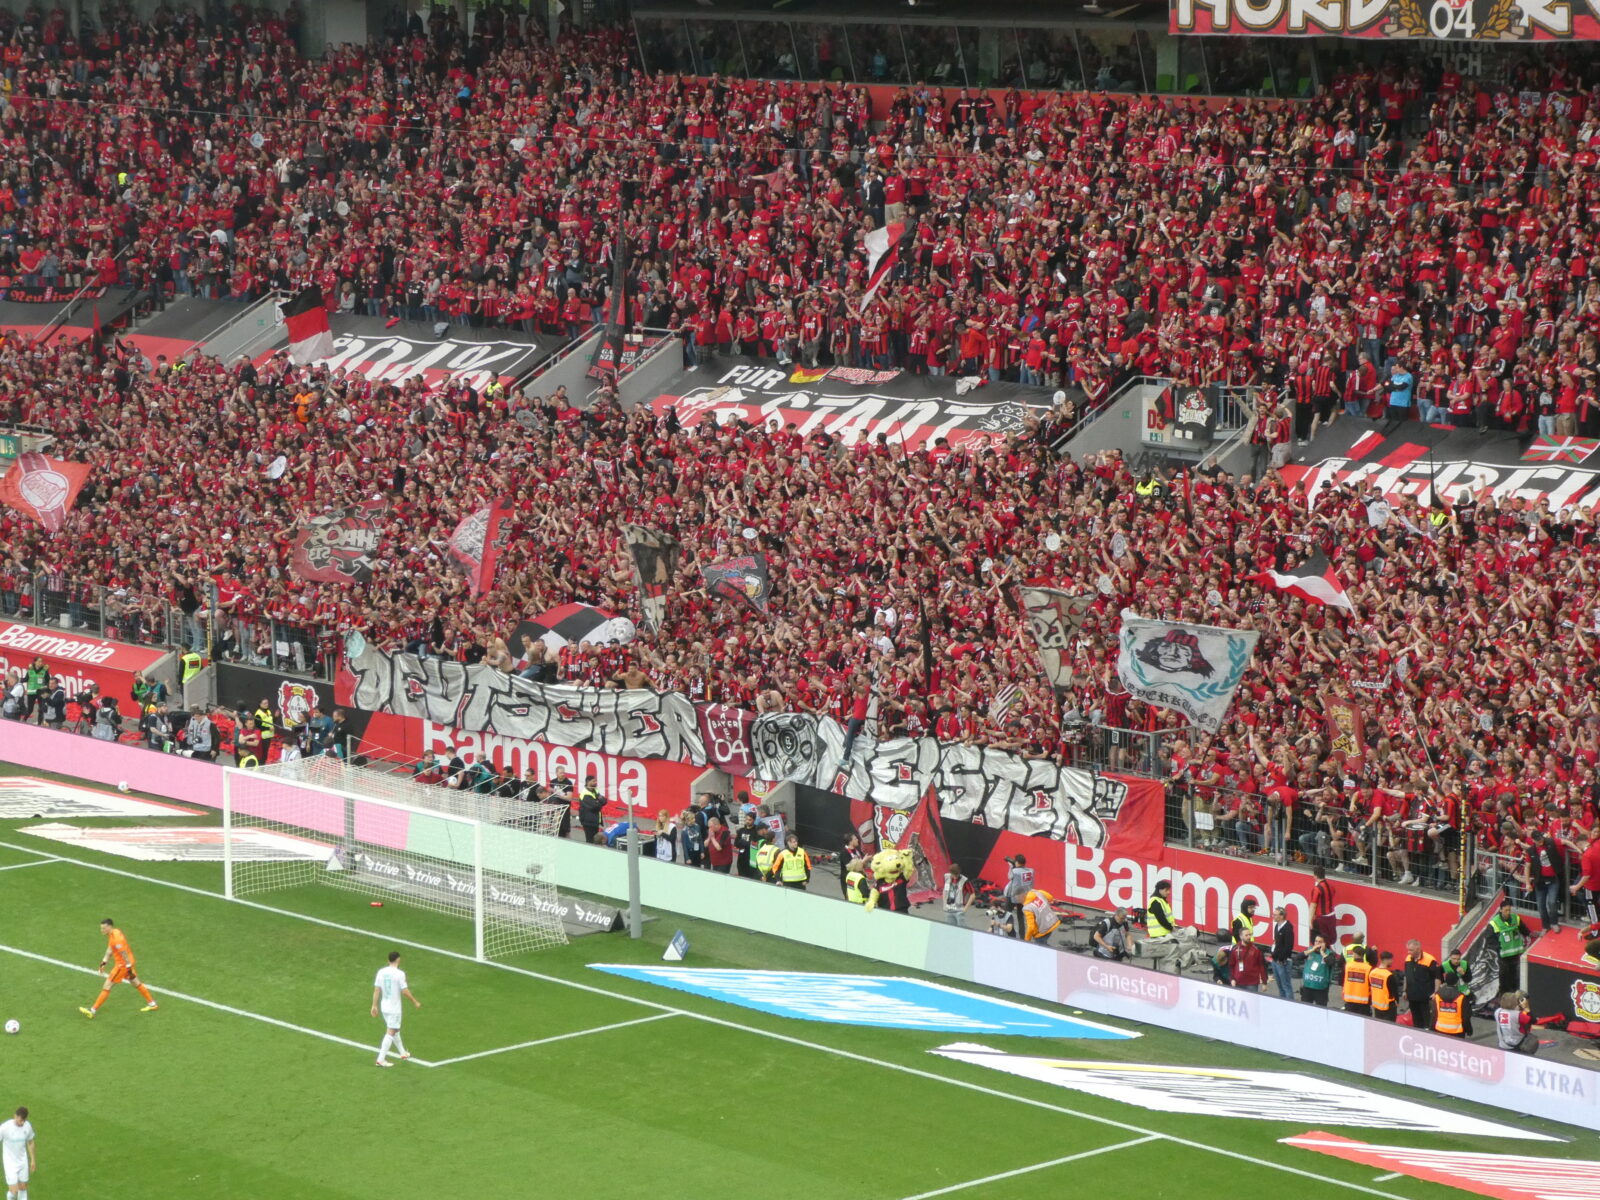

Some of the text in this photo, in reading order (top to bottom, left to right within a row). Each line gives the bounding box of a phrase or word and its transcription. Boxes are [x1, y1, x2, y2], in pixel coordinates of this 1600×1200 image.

[717, 364, 786, 390] FÜR
[0, 624, 115, 664] Barmenia
[349, 646, 708, 767] DEUTSCHER
[1122, 672, 1219, 729] LEVERKUSEN
[714, 738, 749, 765] 04
[373, 860, 400, 877] trive
[415, 870, 441, 887] trive
[456, 880, 477, 896] triv
[500, 890, 526, 907] trive
[1065, 843, 1367, 951] Barmena
[541, 900, 569, 918] trive
[584, 909, 612, 927] trive
[1304, 972, 1325, 983] HOST
[1197, 989, 1249, 1019] EXTRA
[1525, 1065, 1585, 1098] EXTRA
